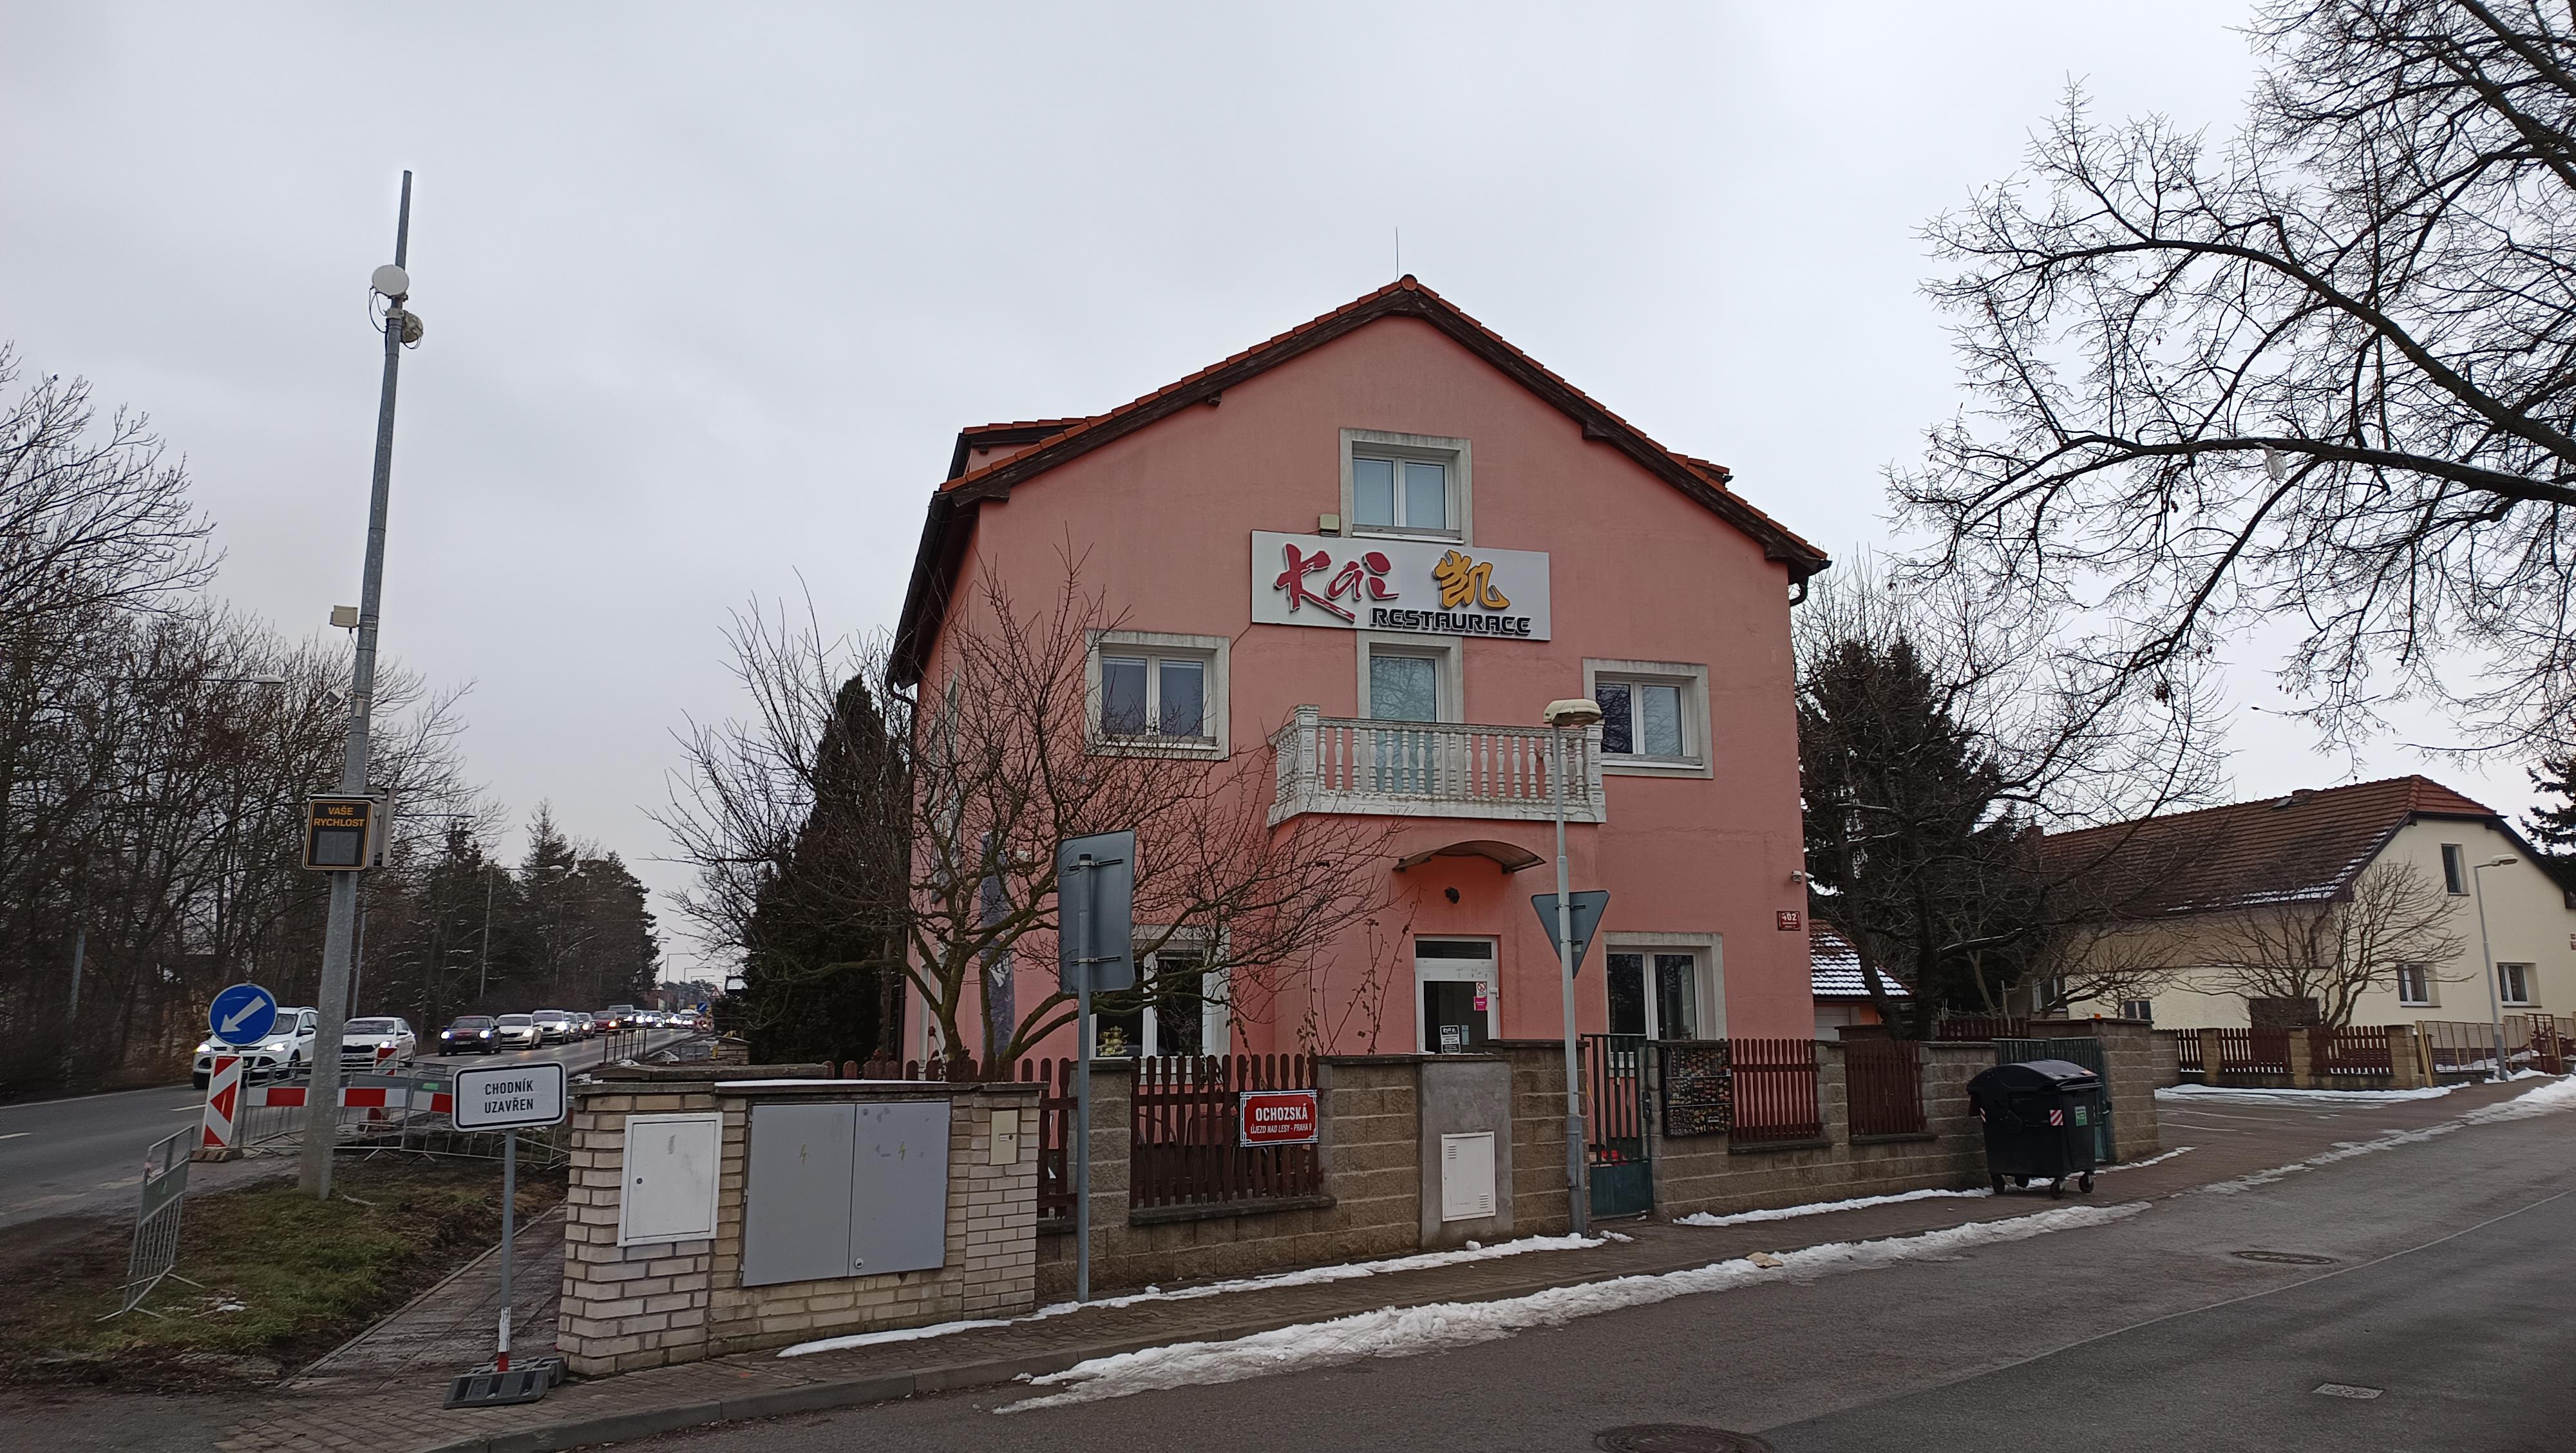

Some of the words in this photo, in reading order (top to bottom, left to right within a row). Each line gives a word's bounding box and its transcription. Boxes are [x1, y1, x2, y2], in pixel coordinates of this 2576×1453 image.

[1274, 543, 1399, 623] Kai
[1371, 608, 1531, 634] RESTAURACE
[328, 805, 354, 815] VAŠE
[314, 818, 365, 827] RYCHLOST
[485, 1078, 534, 1095] CHODNÍK
[484, 1097, 534, 1114] UZAVŘEN
[1255, 1103, 1308, 1121] OCHOZSKÁ
[1251, 1124, 1266, 1134] ÚJEZD
[1278, 1125, 1290, 1133] LESY
[1293, 1123, 1308, 1132] PRAHA
[1309, 1123, 1312, 1131] 9
